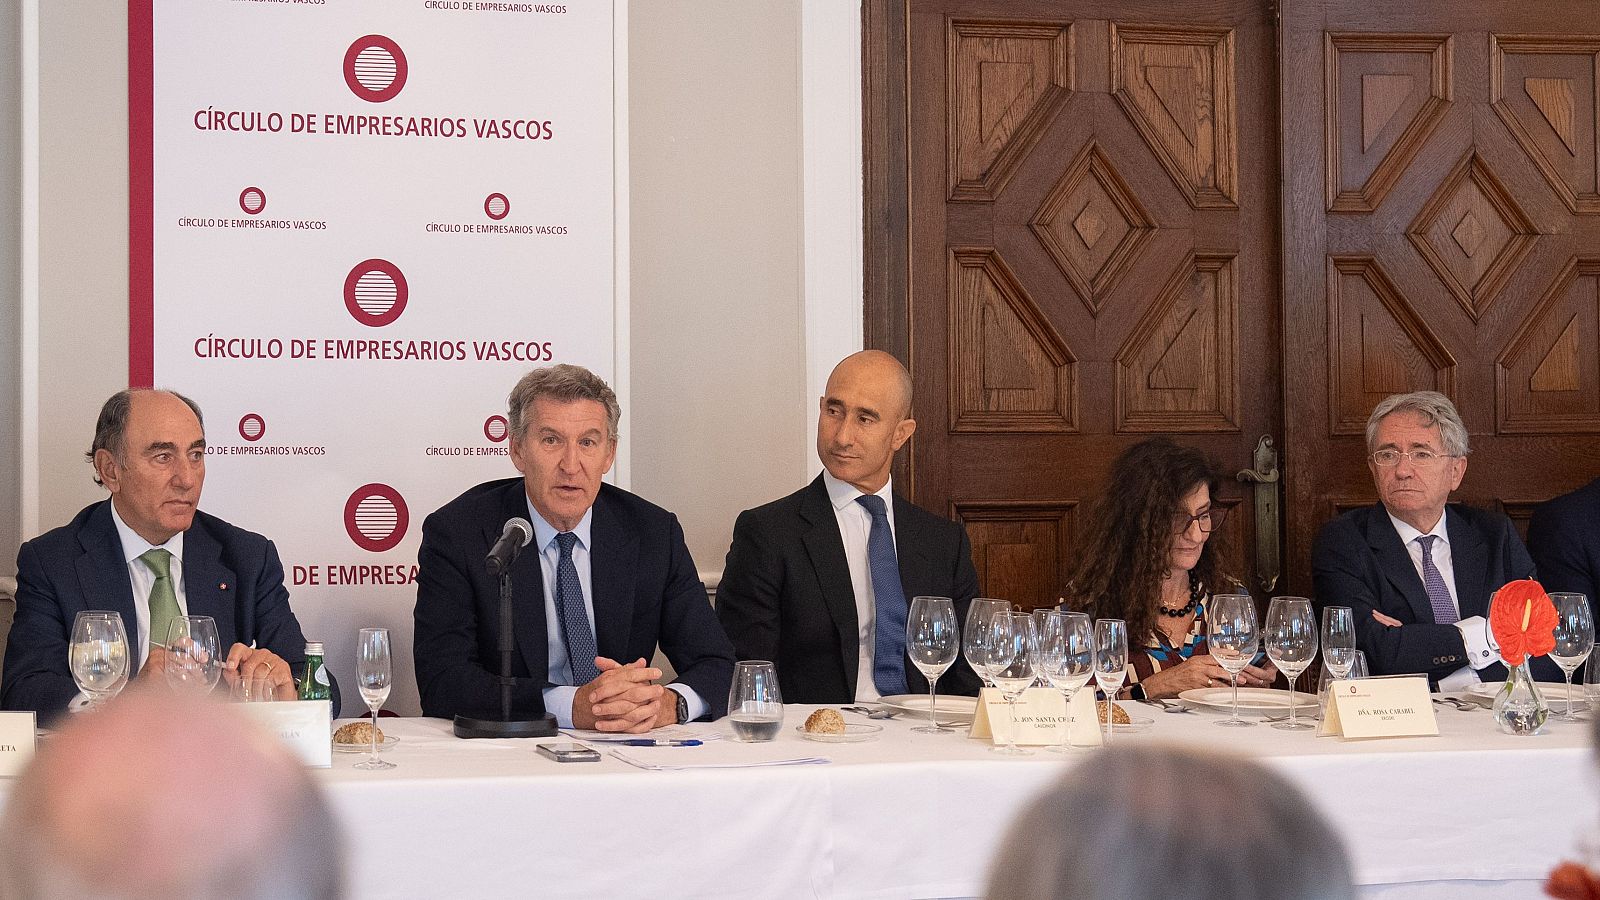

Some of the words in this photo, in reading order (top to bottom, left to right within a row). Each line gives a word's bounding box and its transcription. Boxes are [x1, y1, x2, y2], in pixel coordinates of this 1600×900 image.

[463, 2, 473, 10] DE
[476, 3, 532, 12] EMPRESARIOS
[535, 5, 567, 14] VASCOS
[194, 106, 283, 133] CÍRCULO
[291, 113, 316, 134] DE
[324, 114, 466, 138] EMPRESARIOS
[473, 119, 553, 141] VASCOS
[178, 217, 214, 228] CÍRCULO
[218, 219, 228, 228] DE
[231, 219, 290, 229] EMPRESARIOS
[293, 220, 327, 230] VASCOS
[425, 222, 460, 233] CÍRCULO
[464, 224, 474, 233] DE
[476, 225, 533, 235] EMPRESARIOS
[536, 226, 568, 235] VASCOS
[194, 333, 283, 359] CÍRCULO
[291, 339, 316, 359] DE
[324, 339, 466, 361] EMPRESARIOS
[473, 341, 553, 362] VASCOS
[217, 446, 228, 455] DE
[231, 447, 290, 456] EMPRESARIOS
[292, 447, 326, 456] VASCOS
[425, 445, 460, 456] CÍRCULO
[464, 447, 474, 456] DE
[476, 447, 509, 457] EMPRES
[293, 565, 319, 588] DE
[327, 565, 418, 587] EMPRESA
